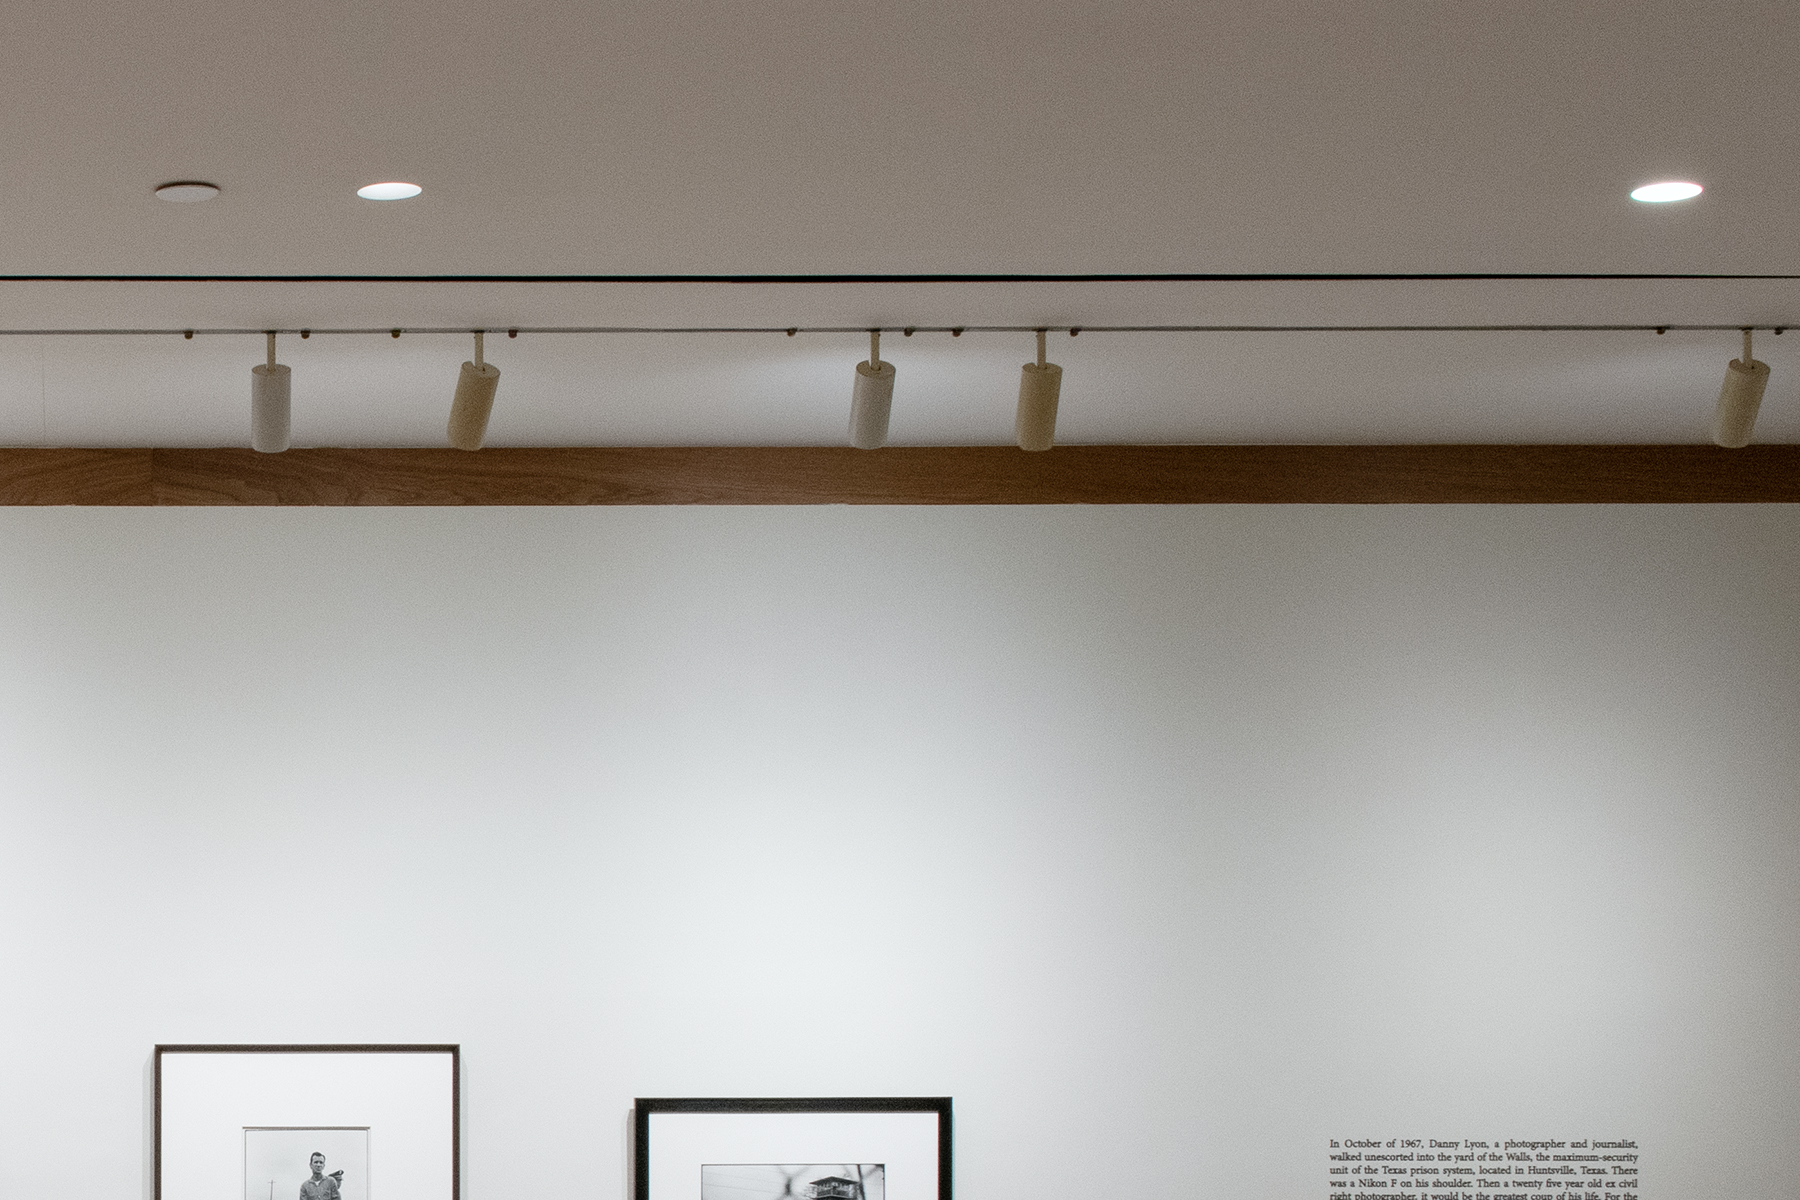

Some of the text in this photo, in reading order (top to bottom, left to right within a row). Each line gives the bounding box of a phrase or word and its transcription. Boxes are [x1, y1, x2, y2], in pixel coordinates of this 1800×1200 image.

[1329, 1138, 1340, 1149] In
[1344, 1138, 1383, 1149] October
[1385, 1138, 1397, 1149] of
[1400, 1138, 1425, 1150] 1967,
[1428, 1138, 1461, 1151] Danny
[1464, 1138, 1490, 1151] Lyon,
[1504, 1138, 1567, 1152] photographer
[1570, 1138, 1589, 1149] and
[1591, 1138, 1639, 1152] journalist,
[1329, 1151, 1639, 1165] walked unescorted into the yard of the Walls, the maximum-security
[1329, 1164, 1639, 1178] unit of the Texas prison system, located in Huntsville, Texas. There
[1329, 1180, 1347, 1188] was
[1358, 1177, 1388, 1188] Nikon
[1399, 1180, 1413, 1188] on
[1414, 1178, 1430, 1188] his
[1431, 1178, 1474, 1188] shoulder.
[1475, 1178, 1501, 1188] Then
[1511, 1179, 1544, 1191] twenty
[1545, 1177, 1563, 1188] five
[1564, 1180, 1585, 1191] year
[1586, 1178, 1603, 1189] old
[1604, 1181, 1617, 1189] ex
[1618, 1178, 1639, 1189] civil
[1420, 1191, 1429, 1200] it
